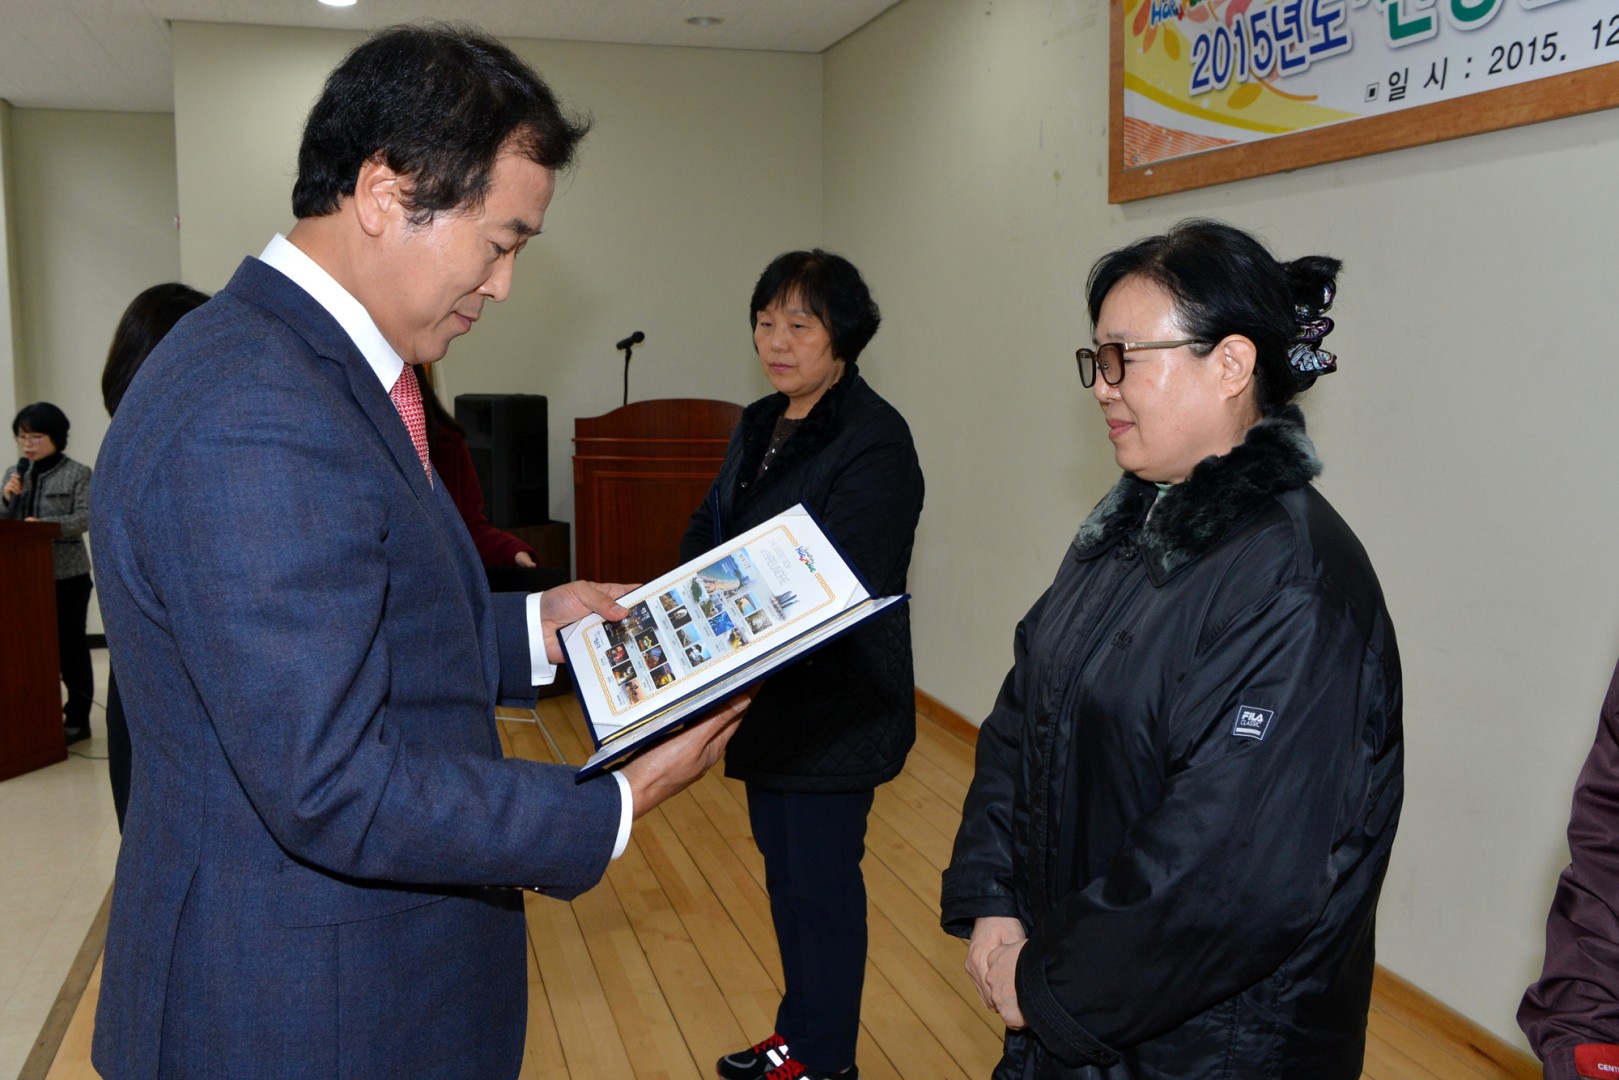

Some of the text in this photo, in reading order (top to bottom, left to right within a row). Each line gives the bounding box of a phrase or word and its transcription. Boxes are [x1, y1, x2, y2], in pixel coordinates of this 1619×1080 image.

[1191, 0, 1349, 90] 2015년도
[1388, 68, 1409, 101] 일
[1424, 57, 1448, 90] 시
[1488, 31, 1567, 75] 2015.
[1242, 711, 1263, 722] FILA
